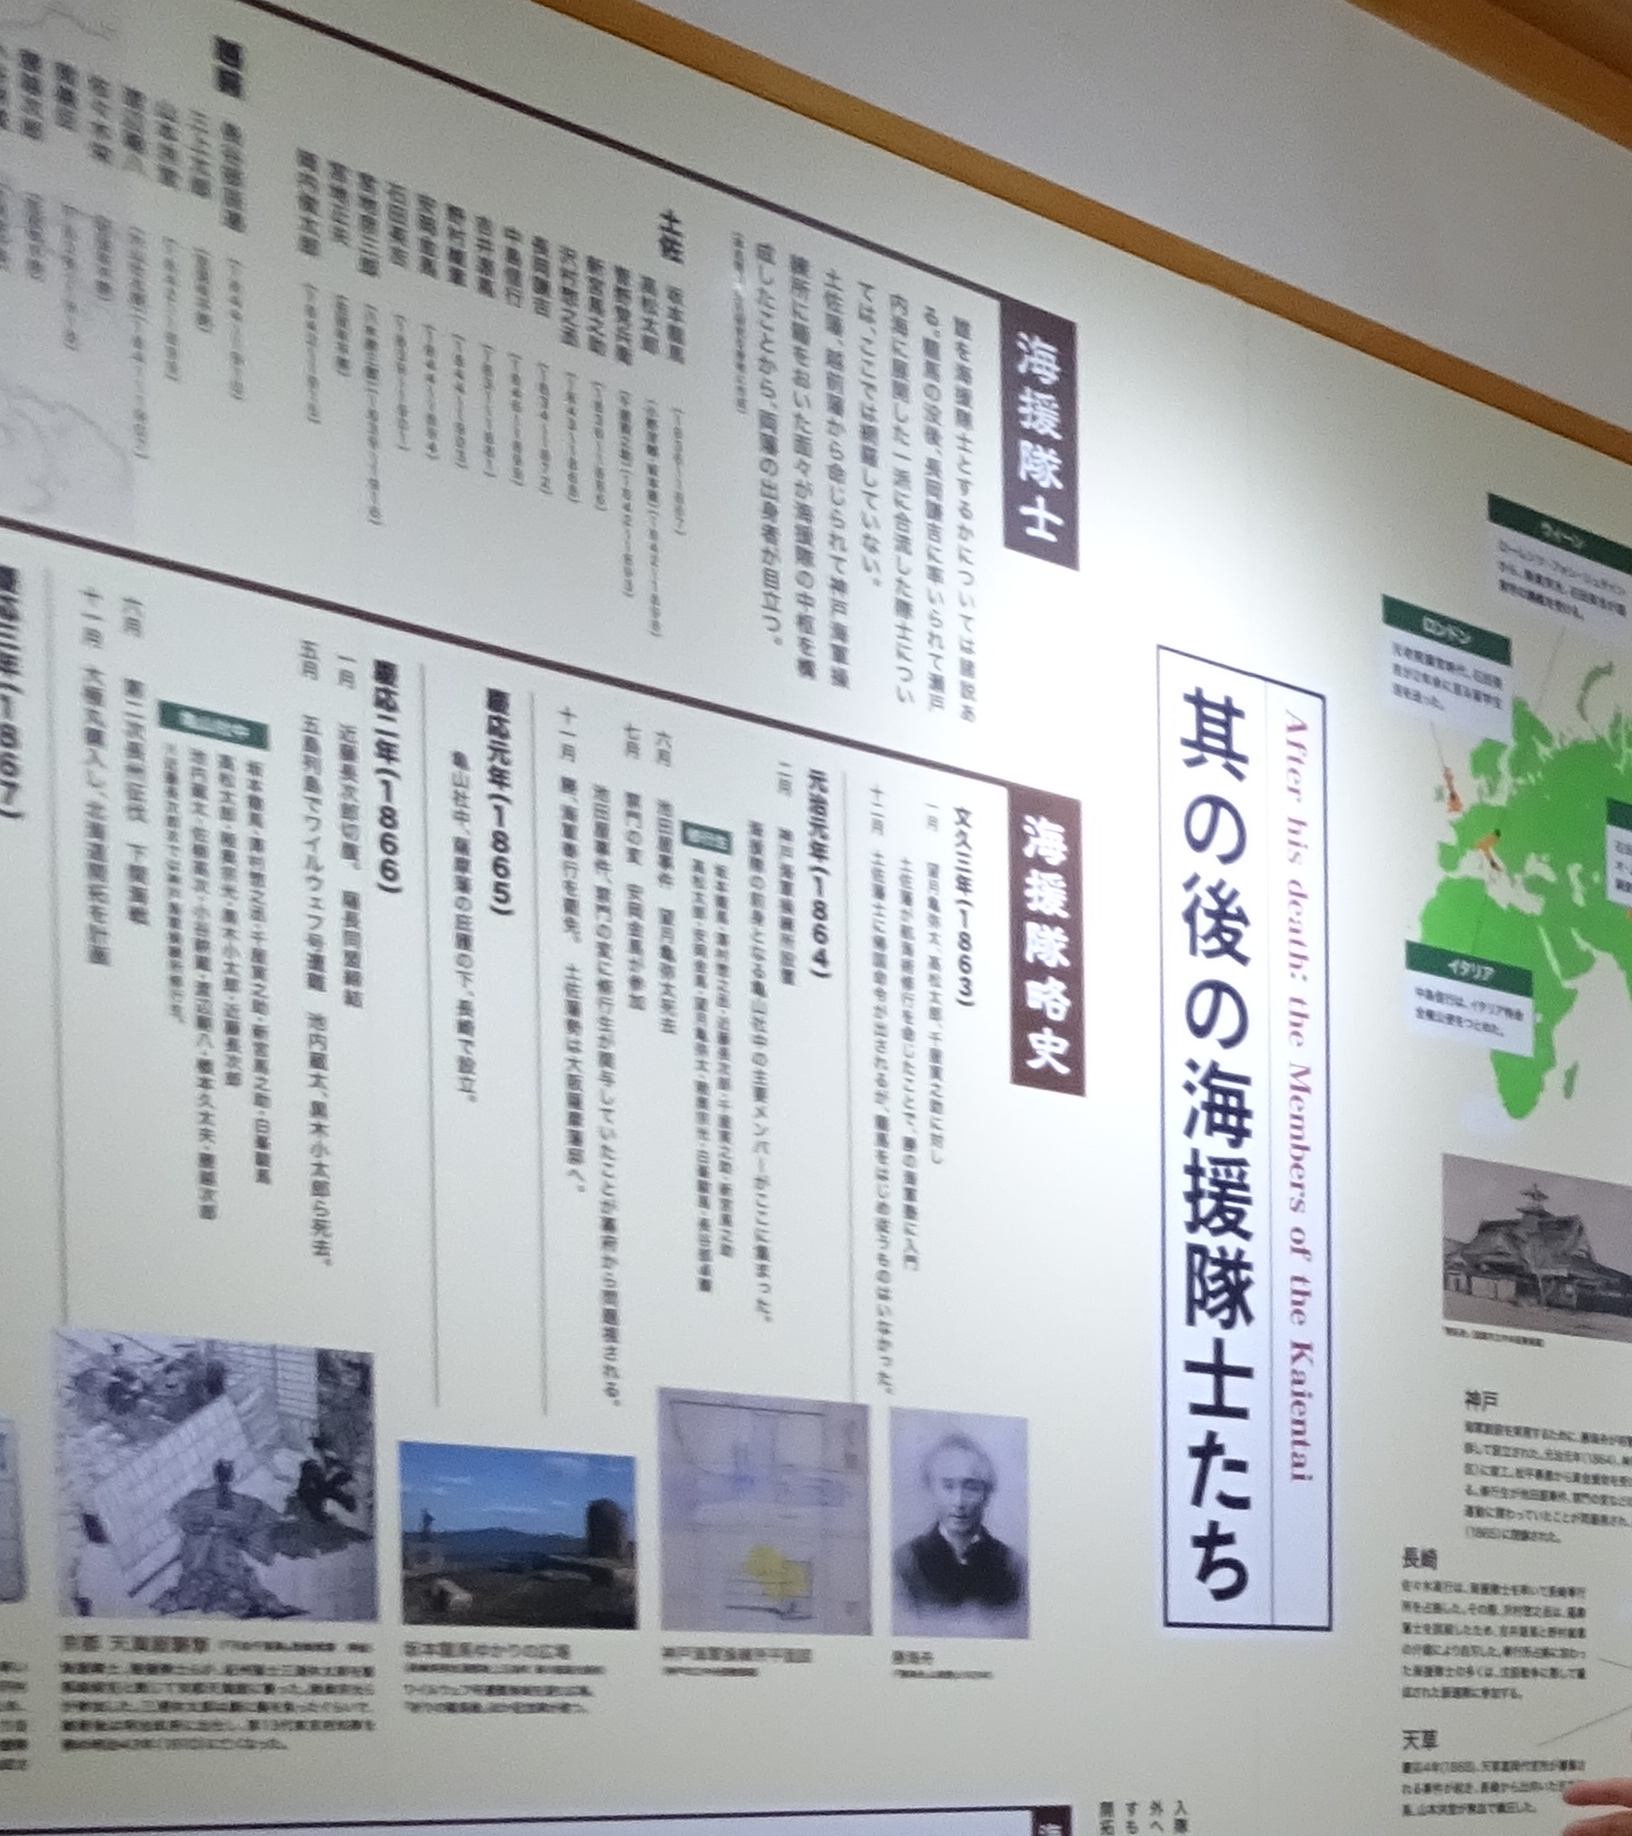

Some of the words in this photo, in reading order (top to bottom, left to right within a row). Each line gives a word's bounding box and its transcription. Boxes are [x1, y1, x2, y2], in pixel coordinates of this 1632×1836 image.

[658, 204, 685, 266] 土佐
[1017, 327, 1064, 547] 海援隊士
[1422, 613, 1472, 648] ロンドン
[1286, 710, 1310, 804] After
[1287, 816, 1310, 866] his
[1022, 811, 1071, 1075] 海援隊略史
[1287, 878, 1310, 981] death:
[1446, 956, 1495, 984] イタリア
[1288, 996, 1310, 1048] the
[1180, 685, 1256, 1604] 其の後の海援隊士たち
[1288, 1063, 1311, 1214] Members
[1289, 1227, 1312, 1262] of
[1289, 1274, 1312, 1327] the
[1290, 1341, 1313, 1482] Kaientai
[1464, 1388, 1499, 1413] 神戸
[1401, 1545, 1438, 1570] 長崎
[1401, 1728, 1438, 1751] 天草
